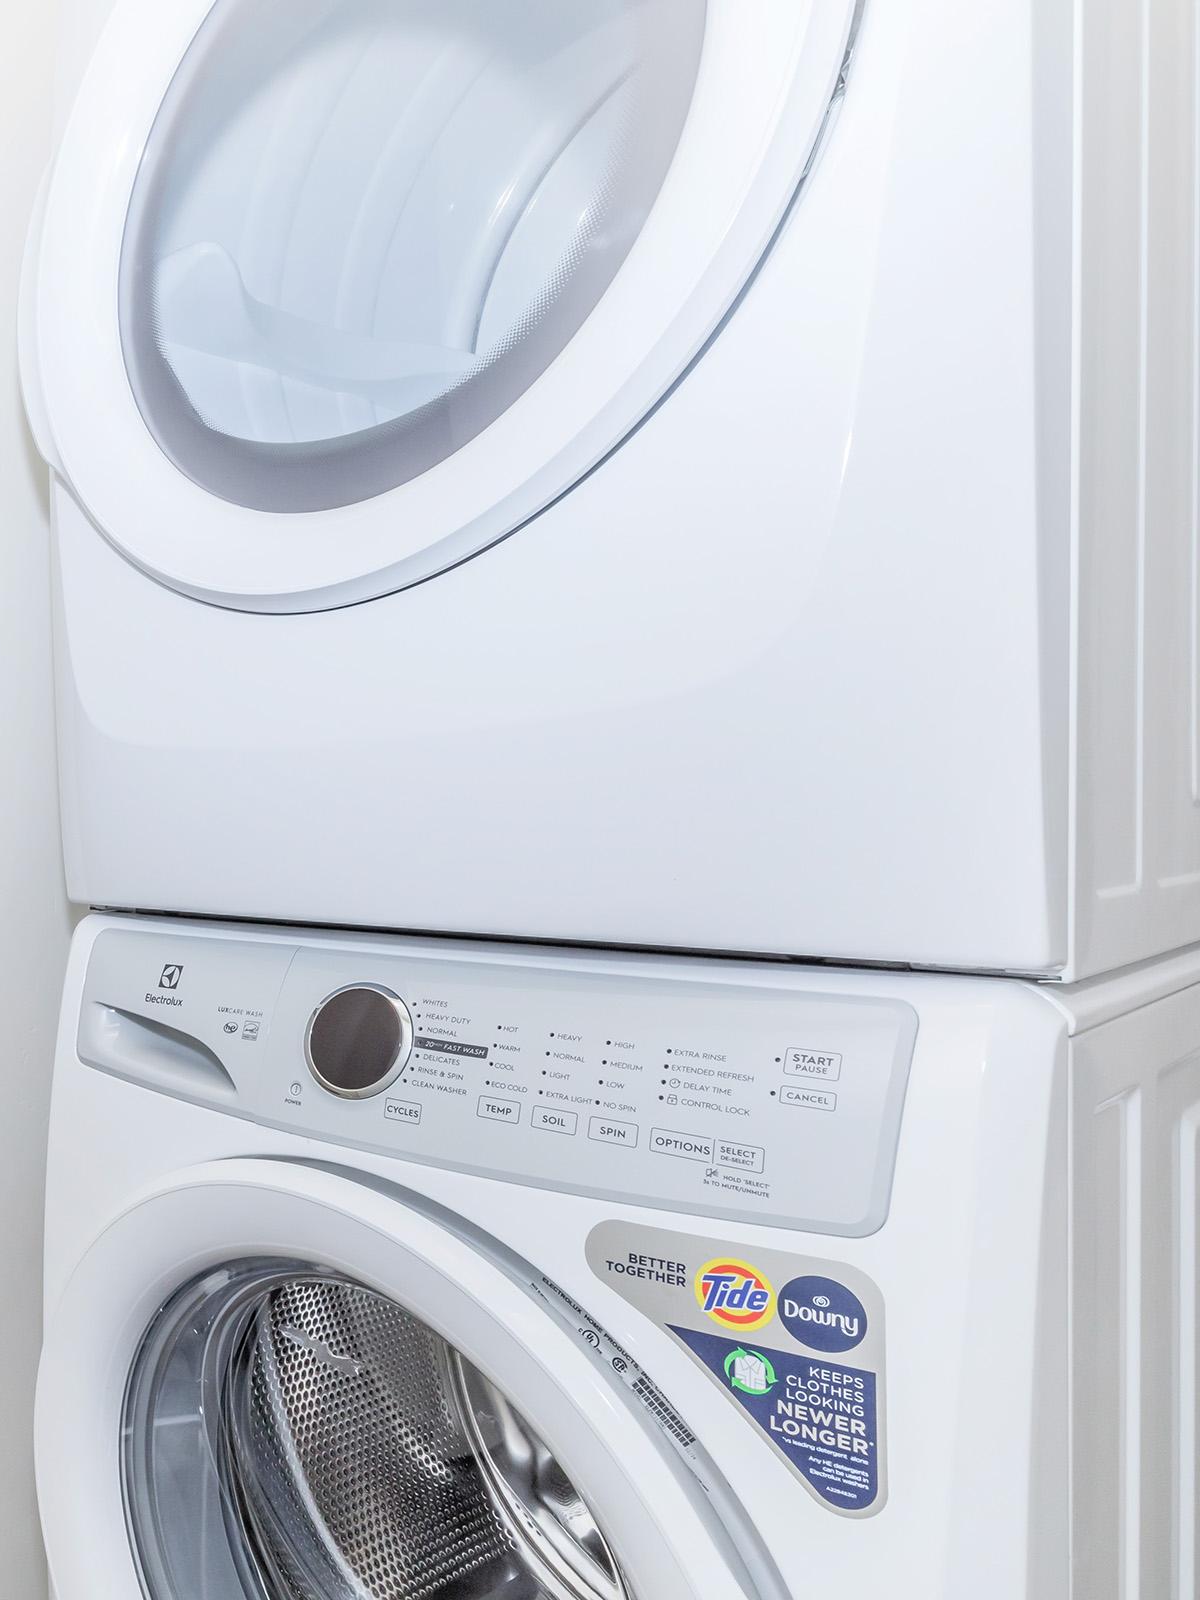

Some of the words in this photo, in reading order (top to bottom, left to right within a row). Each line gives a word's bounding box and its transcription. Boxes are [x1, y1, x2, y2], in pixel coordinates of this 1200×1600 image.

[145, 993, 183, 1006] Electrolux
[422, 999, 448, 1007] WHITES
[426, 1013, 449, 1022] HEAVY
[451, 1016, 471, 1024] DUTY
[427, 1027, 457, 1037] NORMAL
[557, 1033, 582, 1042] HEAVY
[463, 1047, 485, 1055] WASH
[614, 1041, 635, 1050] HIGH
[423, 1054, 460, 1066] DELICATES
[553, 1052, 585, 1063] NORMAL
[674, 1049, 700, 1058] EXTRA
[702, 1052, 727, 1062] RINSE
[792, 1053, 834, 1067] START
[418, 1066, 437, 1075] RINSE
[447, 1072, 464, 1080] SPIN
[494, 1063, 514, 1071] COOL
[610, 1061, 643, 1072] MEDIUM
[795, 1064, 828, 1075] PAUSE
[549, 1071, 570, 1080] LIGHT
[671, 1064, 715, 1077] EXTENDED
[717, 1071, 755, 1083] REFRESH
[411, 1080, 434, 1089] CLEAN
[437, 1084, 467, 1095] WASHER
[491, 1081, 506, 1089] ECO
[507, 1084, 528, 1093] COLD
[606, 1081, 625, 1089] LOW
[683, 1081, 710, 1092] DELAY
[712, 1086, 733, 1096] TIME
[284, 1098, 301, 1106] POWER
[546, 1091, 569, 1101] EXTRA
[571, 1095, 593, 1105] LIGHT
[786, 1092, 829, 1105] CANCEL
[387, 1105, 419, 1118] CYCLES
[485, 1104, 512, 1116] TEMP
[603, 1101, 616, 1110] NO
[618, 1104, 636, 1113] SPIN
[681, 1098, 723, 1112] CONTROL
[725, 1106, 750, 1116] LOCK
[542, 1115, 566, 1127] SOIL
[600, 1126, 626, 1139] SPIN
[655, 1136, 711, 1155] OPTIONS
[720, 1145, 756, 1159] SELECT
[720, 1155, 754, 1166] DE-SELECT
[723, 1175, 742, 1183] HOLD
[721, 1183, 769, 1198] MUTE/UNMUTE
[628, 1252, 687, 1275] BETTER
[606, 1260, 687, 1288] TOGETHER
[701, 1273, 769, 1313] Tide
[542, 1276, 582, 1315] ELECTROLUX
[584, 1313, 603, 1334] HOME
[784, 1298, 859, 1337] Downy
[809, 1366, 865, 1389] KEEPS
[786, 1375, 865, 1403] CLOTHES
[786, 1388, 865, 1417] LOOKING
[777, 1400, 866, 1437] NEWER
[792, 1439, 815, 1451] leading
[850, 1456, 869, 1465] alone
[808, 1455, 821, 1464] Any
[822, 1459, 833, 1467] HE
[833, 1463, 869, 1477] detergents
[809, 1467, 841, 1482] Electrolux
[842, 1478, 870, 1490] washers
[822, 1466, 835, 1474] can
[845, 1473, 862, 1481] used
